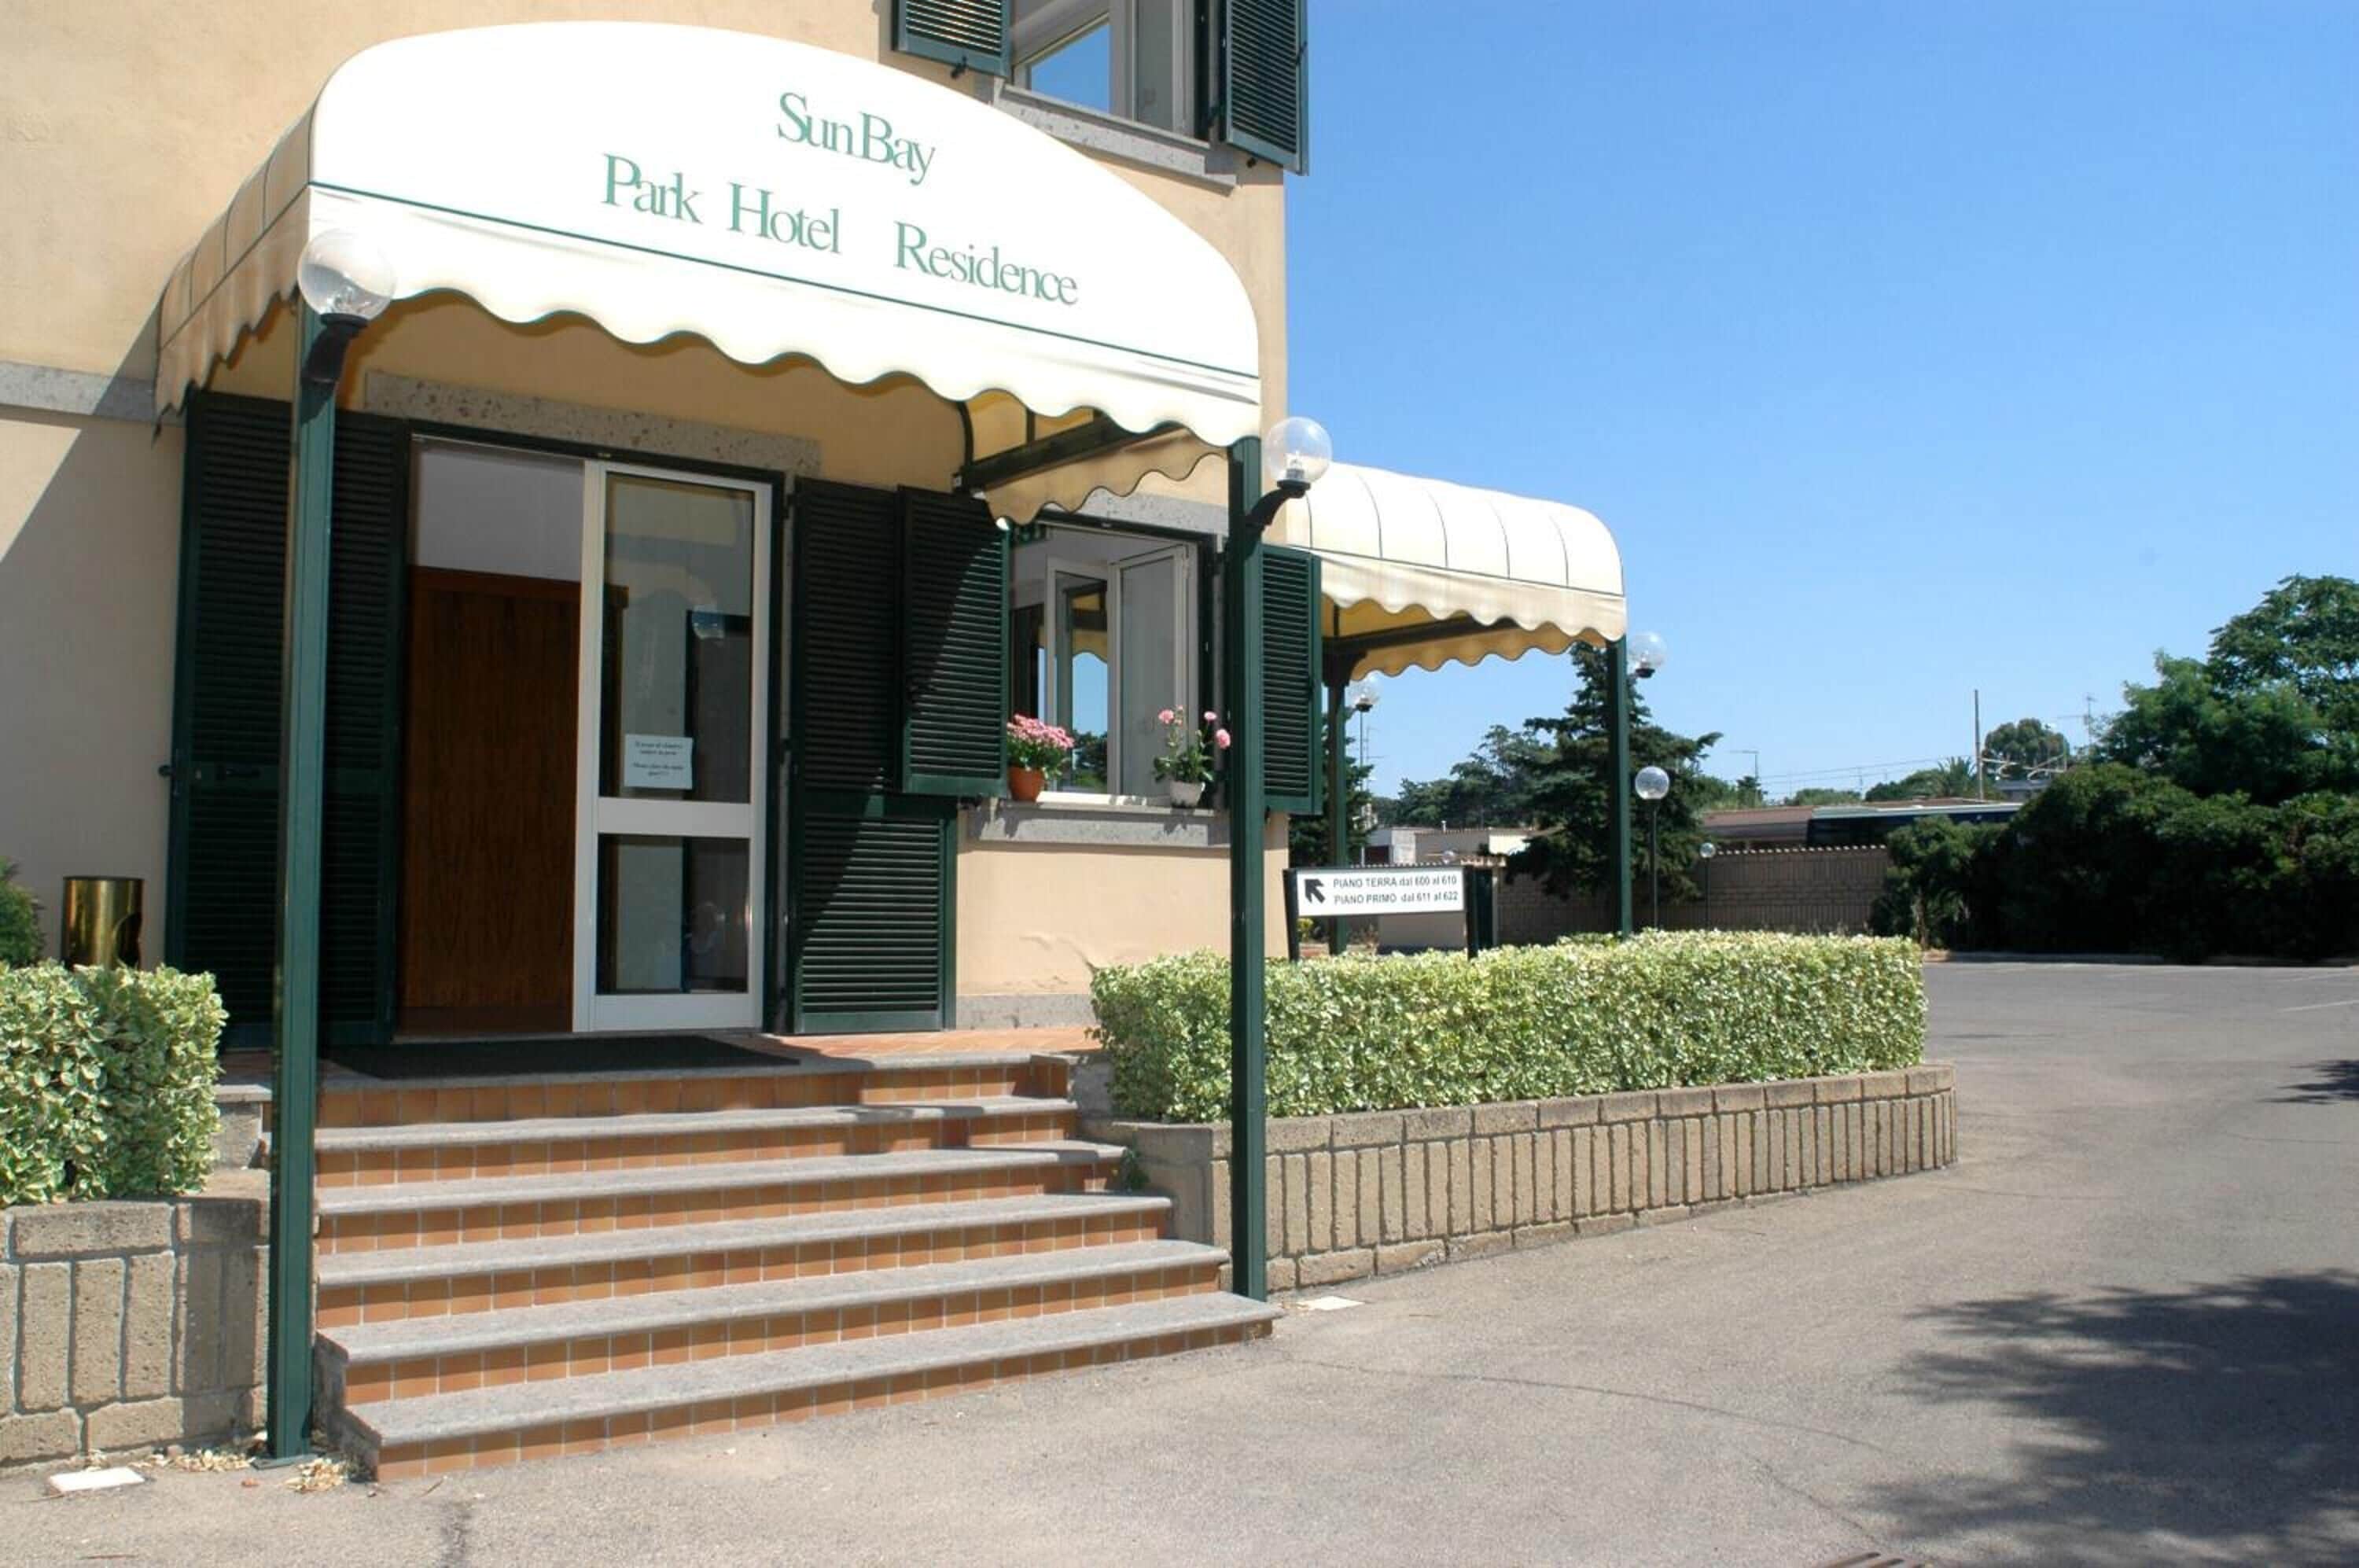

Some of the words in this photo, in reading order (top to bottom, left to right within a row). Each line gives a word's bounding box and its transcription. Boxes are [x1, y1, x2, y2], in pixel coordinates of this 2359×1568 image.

[602, 153, 701, 224] Park
[728, 182, 842, 254] Hotel
[893, 221, 1078, 306] Residence
[1333, 878, 1363, 888] PIANO
[1365, 878, 1397, 887] TERRA
[1399, 877, 1412, 886] dal
[1415, 876, 1430, 885] 600
[1433, 875, 1440, 885] al
[1442, 875, 1457, 885] 610
[1334, 894, 1364, 904] PIANO
[1367, 893, 1397, 904] PRIMO
[1400, 893, 1415, 902] dal
[1417, 893, 1430, 902] 611
[1434, 892, 1441, 901] al
[1444, 891, 1459, 901] 622
